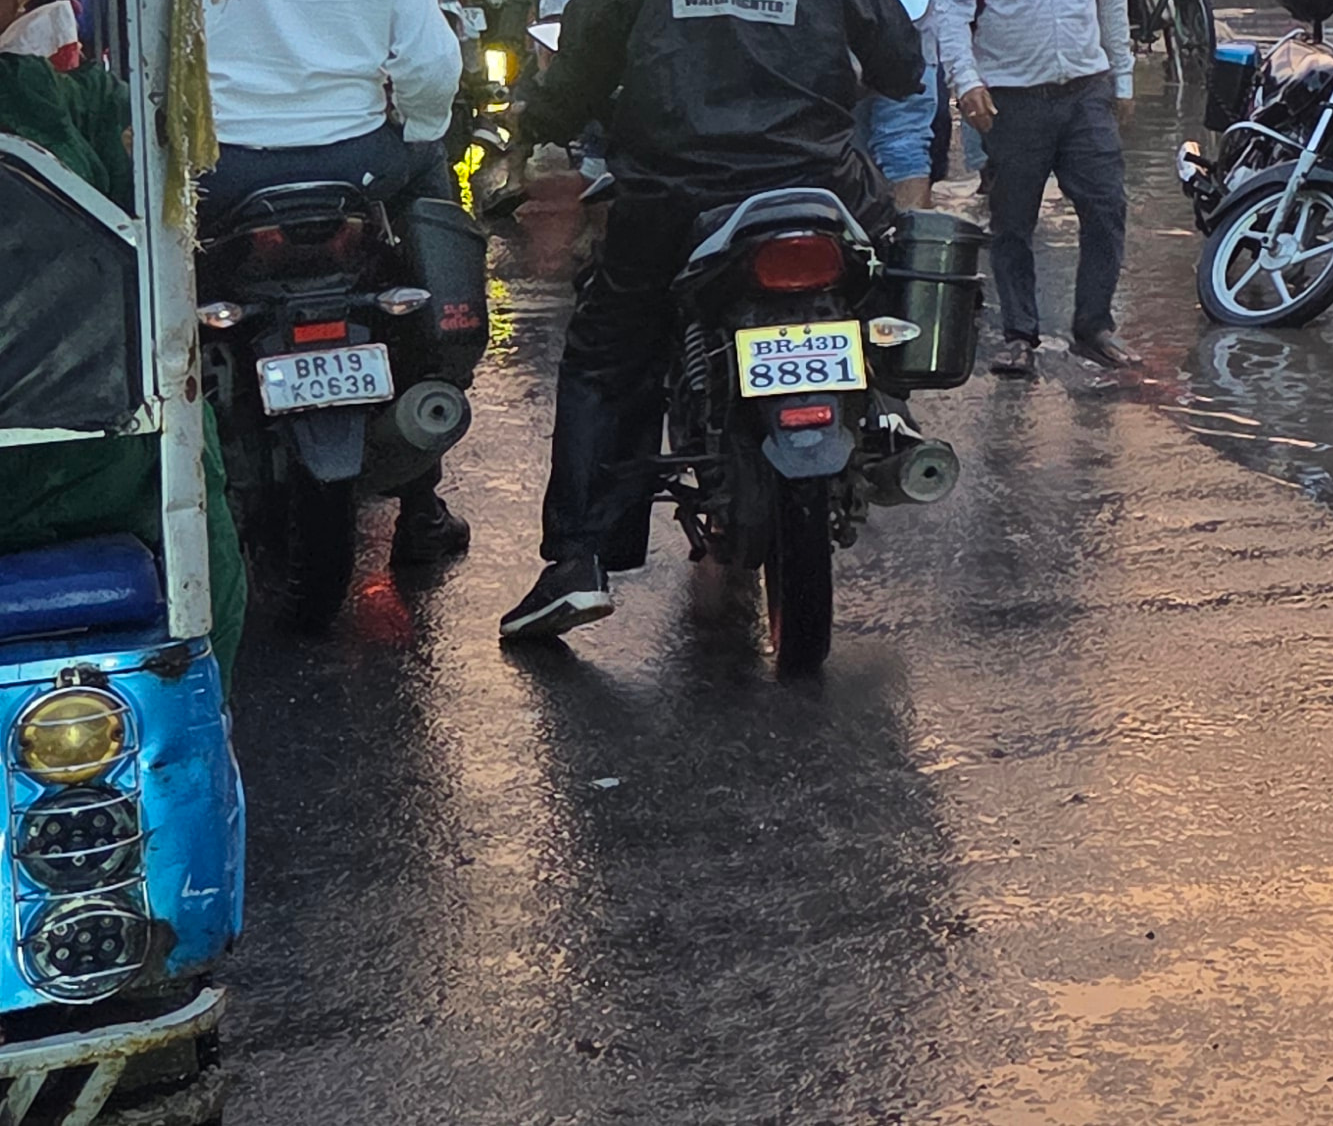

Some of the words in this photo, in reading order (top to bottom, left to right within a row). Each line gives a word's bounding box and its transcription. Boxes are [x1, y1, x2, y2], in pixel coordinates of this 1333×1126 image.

[753, 335, 849, 356] BR-43D
[295, 353, 362, 378] BR19
[750, 357, 856, 388] 8881
